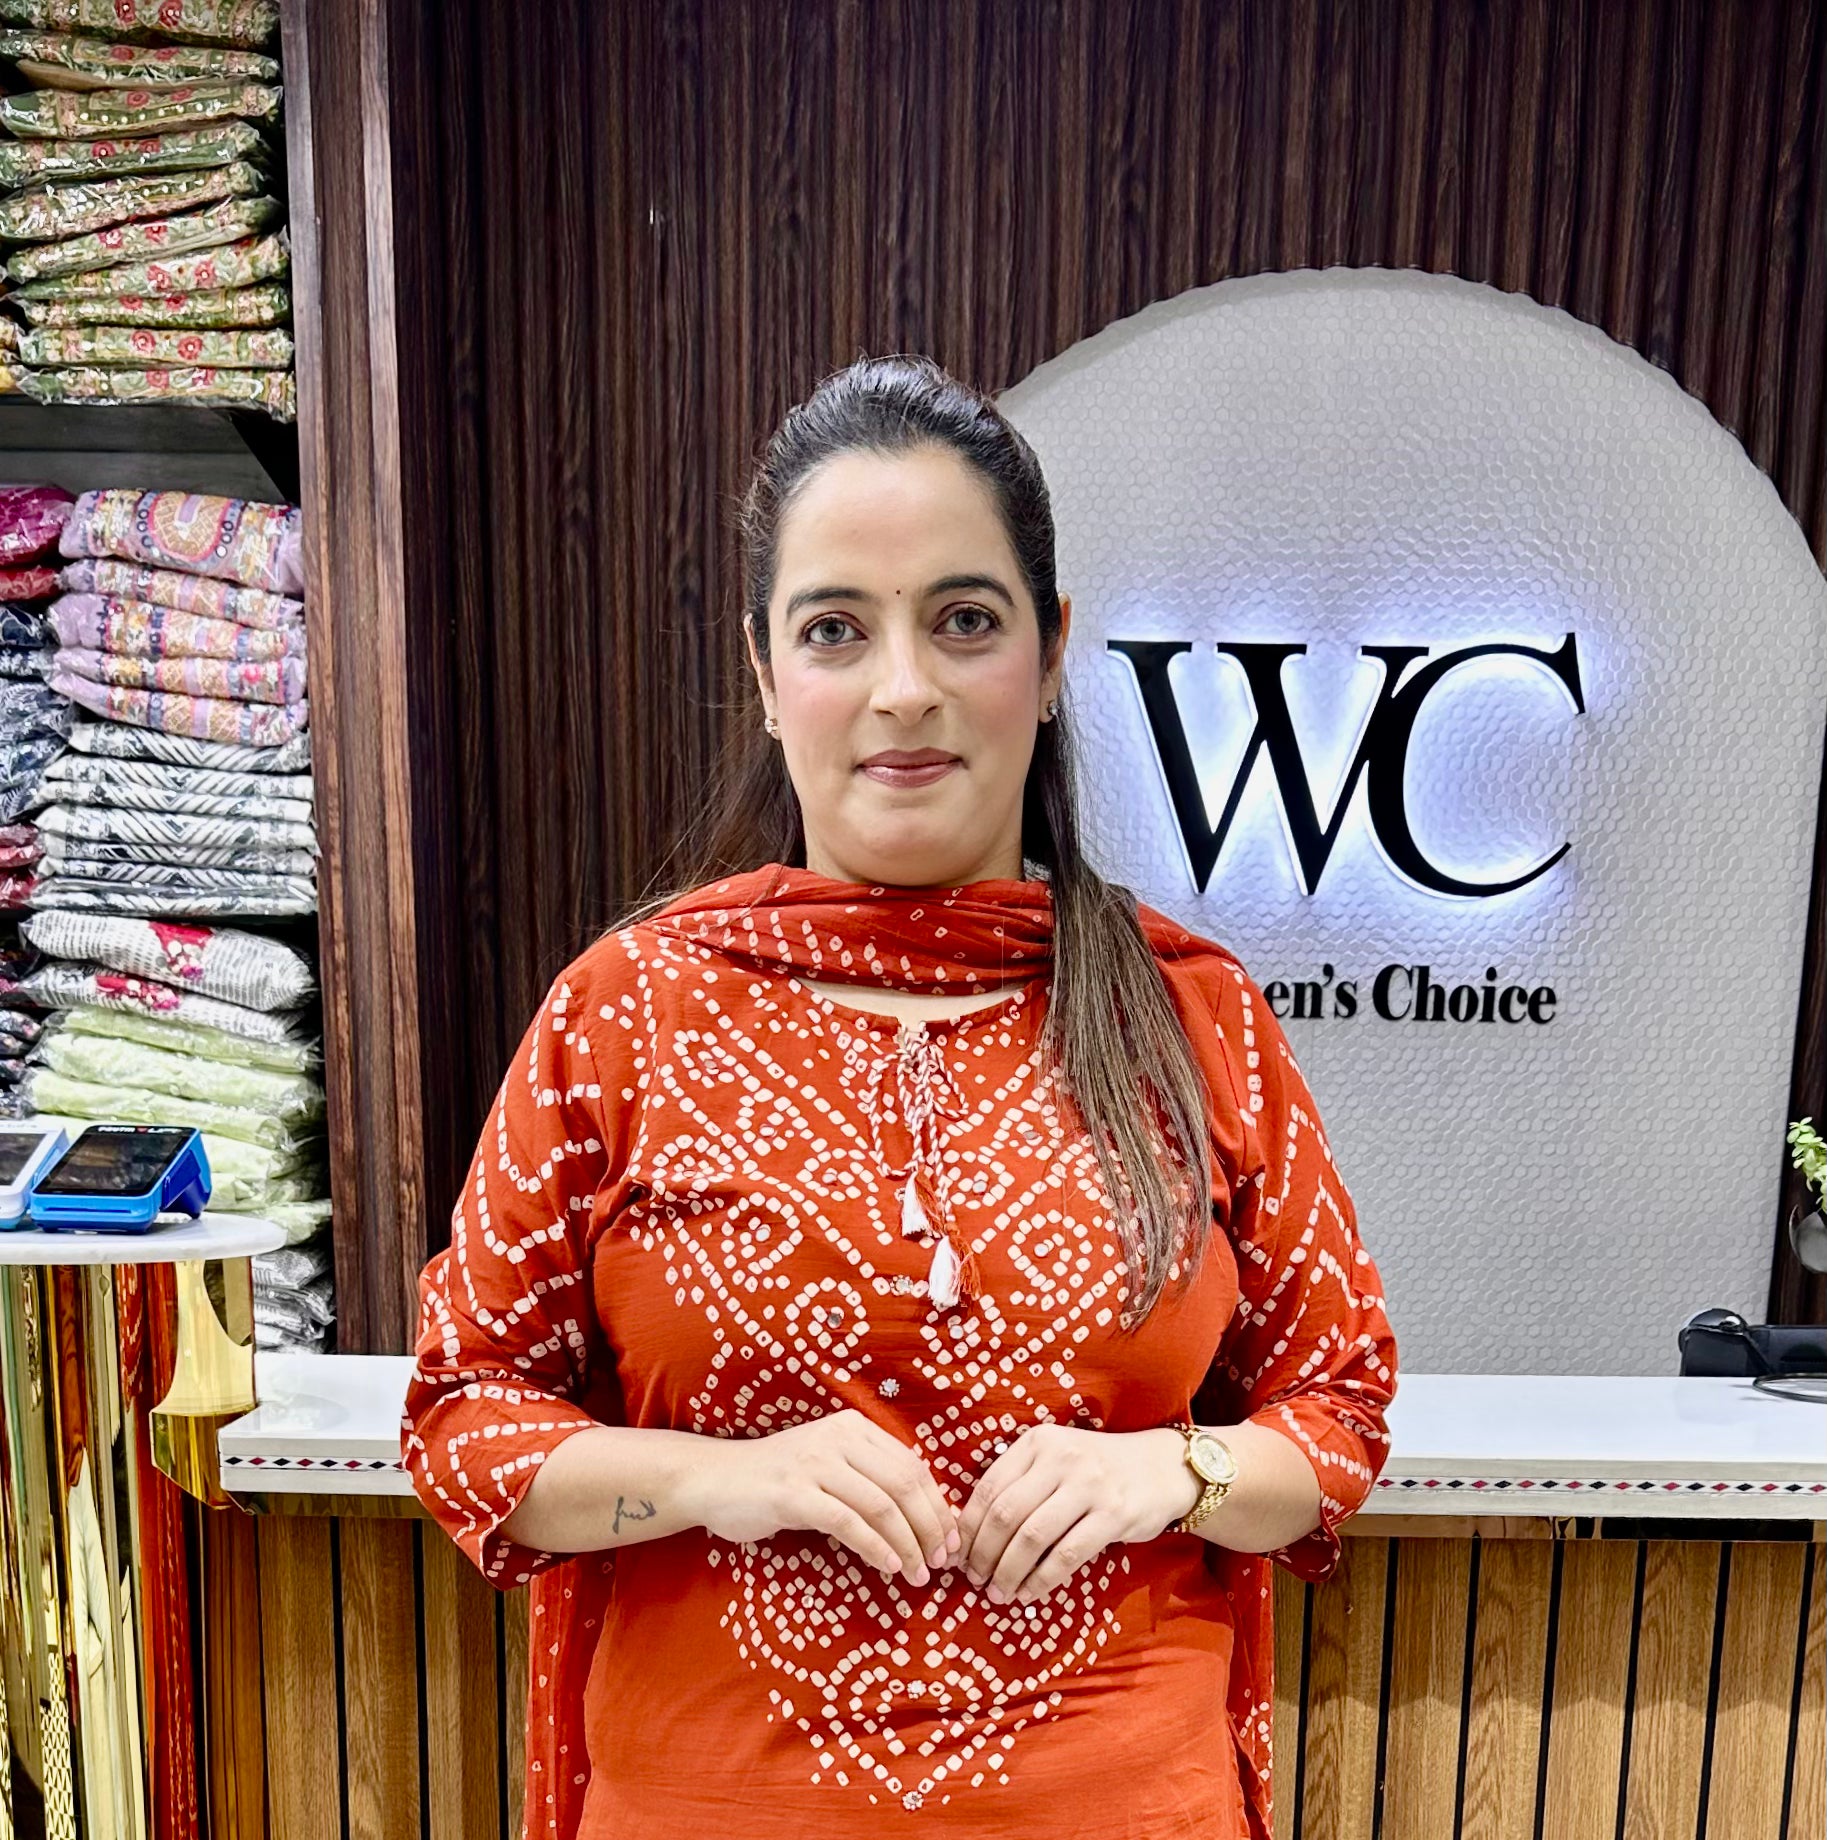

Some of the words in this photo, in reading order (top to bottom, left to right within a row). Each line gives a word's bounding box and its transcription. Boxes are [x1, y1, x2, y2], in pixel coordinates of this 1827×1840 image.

[1107, 632, 1585, 898] WC
[1263, 963, 1358, 1019] en's
[1372, 963, 1557, 1025] Choice
